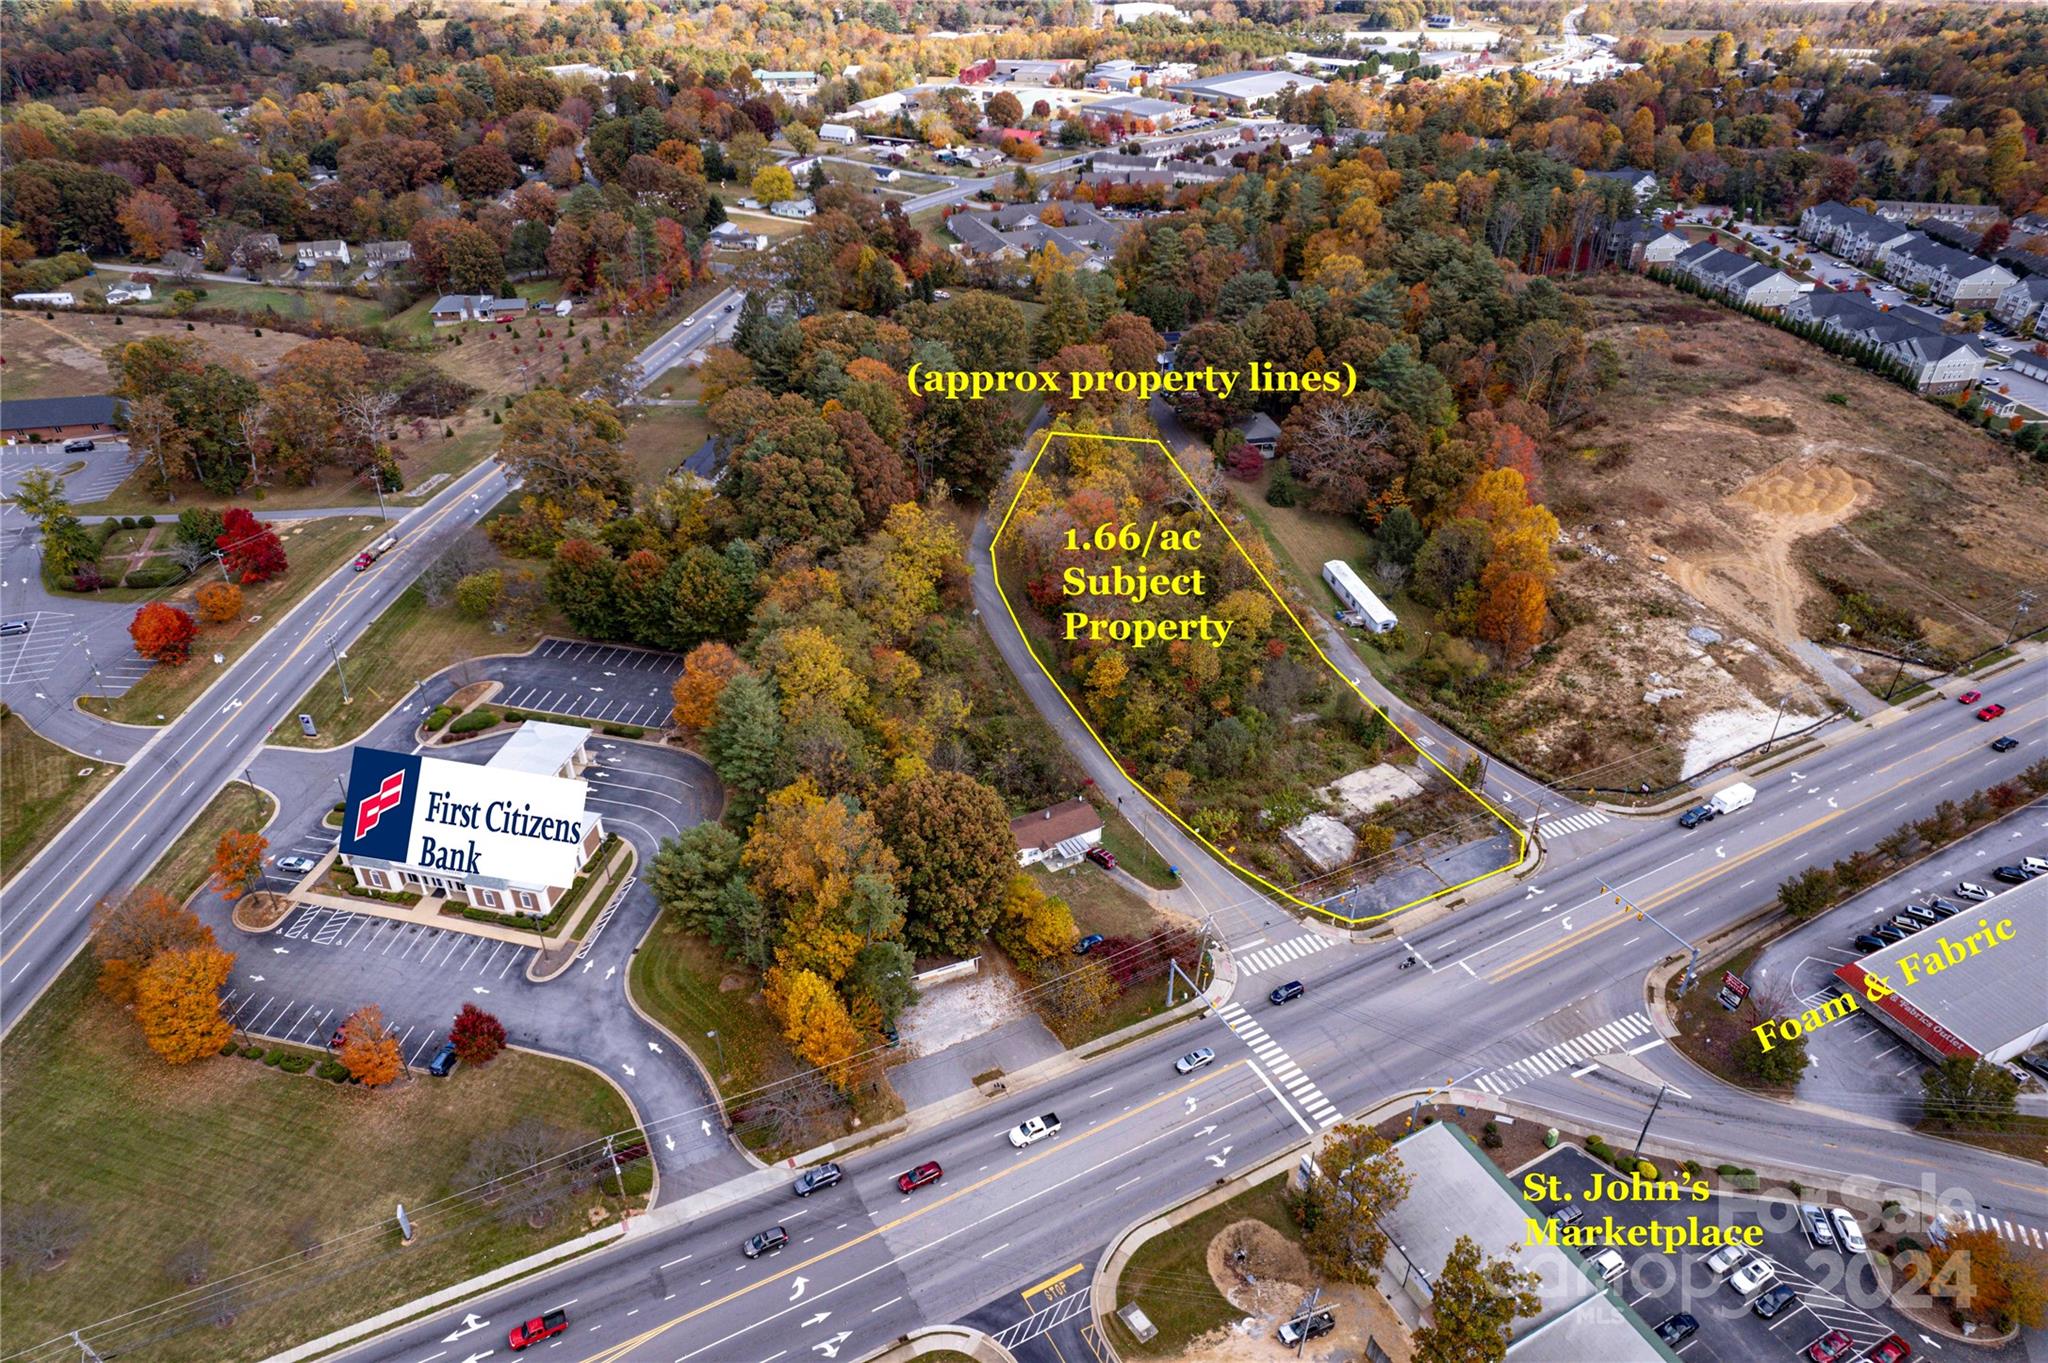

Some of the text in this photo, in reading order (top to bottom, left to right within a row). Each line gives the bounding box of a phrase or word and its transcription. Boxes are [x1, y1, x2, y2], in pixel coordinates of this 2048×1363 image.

[1899, 999, 1933, 1028] Fabrics
[1933, 1026, 1965, 1050] Outlet
[1043, 1281, 1067, 1301] STOP
